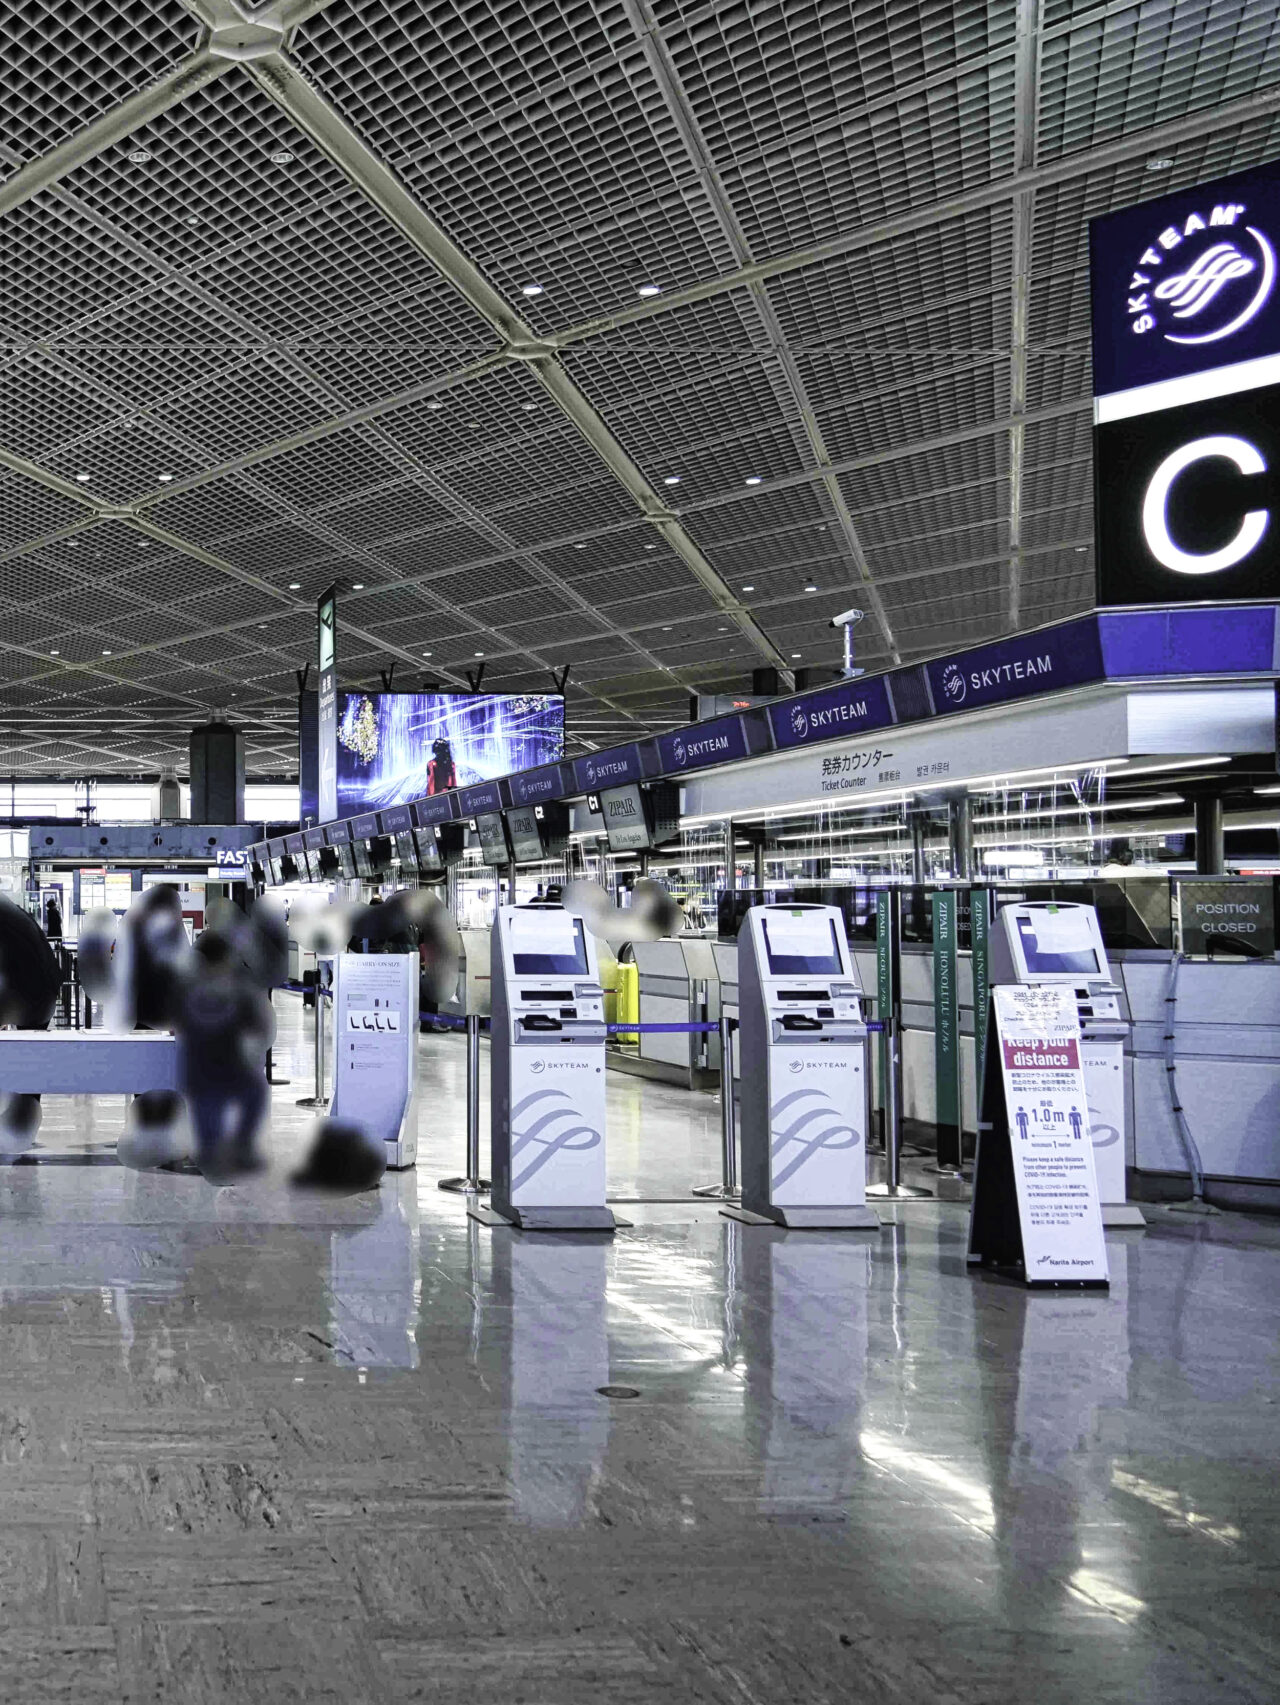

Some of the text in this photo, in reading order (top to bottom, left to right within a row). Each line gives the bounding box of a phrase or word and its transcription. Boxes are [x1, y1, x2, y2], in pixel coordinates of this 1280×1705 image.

[1127, 202, 1240, 334] SKYTEAM
[1142, 434, 1269, 575] C
[971, 654, 1053, 690] SKYTEAM
[811, 701, 868, 728] SKYTEAM
[687, 735, 729, 757] SKYTEAM
[596, 760, 628, 778] SKYTEAM
[821, 749, 894, 776] 発券カウンター
[527, 780, 553, 794] SKYTEAM
[821, 776, 867, 791] Ticket Counter
[588, 795, 599, 810] C1
[608, 798, 636, 817] ZIPAIR
[1195, 903, 1260, 914] POSITION
[939, 902, 948, 940] ZIPAIR
[975, 901, 984, 940] ZIPAIR
[1201, 922, 1257, 933] CLOSED
[940, 950, 950, 1018] HONOLULU
[976, 950, 987, 1021] SINGAPORE
[1042, 1038, 1070, 1050] your
[1013, 1051, 1069, 1066] distance
[1071, 1259, 1094, 1267] Airport
